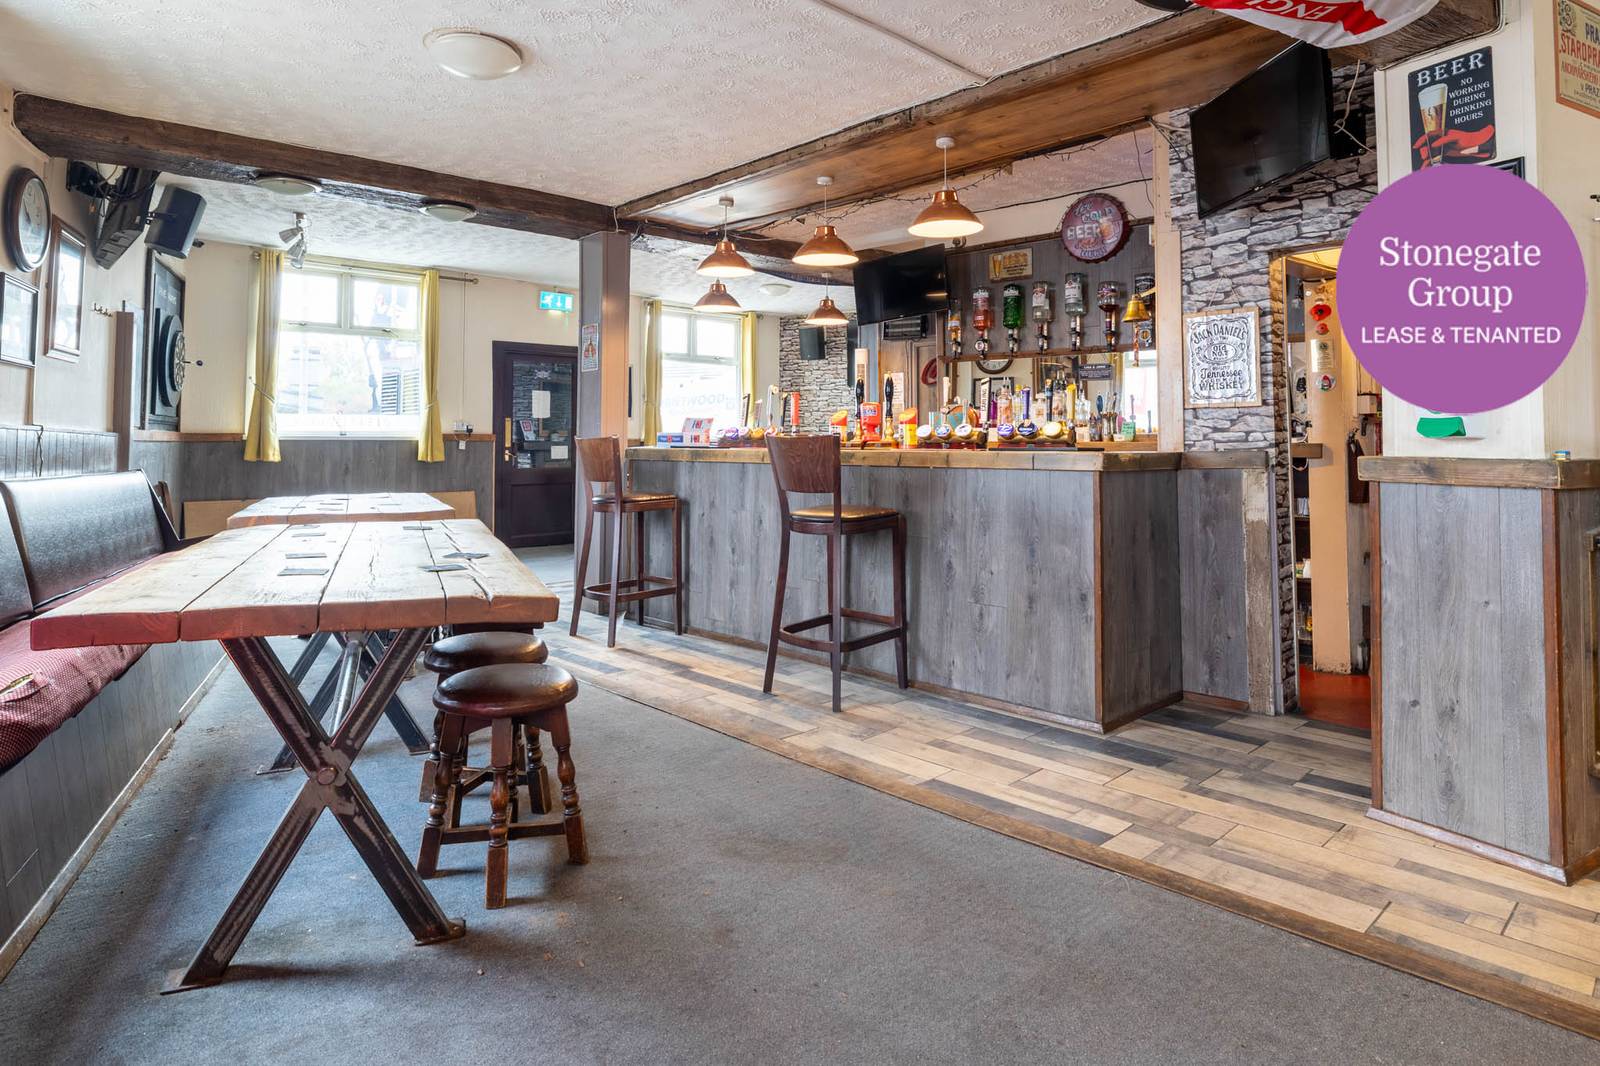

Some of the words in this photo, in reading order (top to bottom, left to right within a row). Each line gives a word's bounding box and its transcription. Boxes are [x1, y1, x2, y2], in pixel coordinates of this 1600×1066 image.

[1246, 0, 1337, 20] ENG
[1416, 52, 1486, 87] BEER
[1448, 80, 1490, 99] WORKING
[1460, 77, 1473, 86] NO
[1449, 98, 1492, 117] DRINKING
[1453, 91, 1486, 107] DURING
[1454, 111, 1484, 125] HOURS
[1067, 223, 1101, 240] BEER
[1193, 329, 1213, 345] JACK
[1213, 323, 1246, 341] DANIEL'S
[1200, 367, 1243, 380] Tennessee
[1199, 380, 1245, 391] WHISKEY
